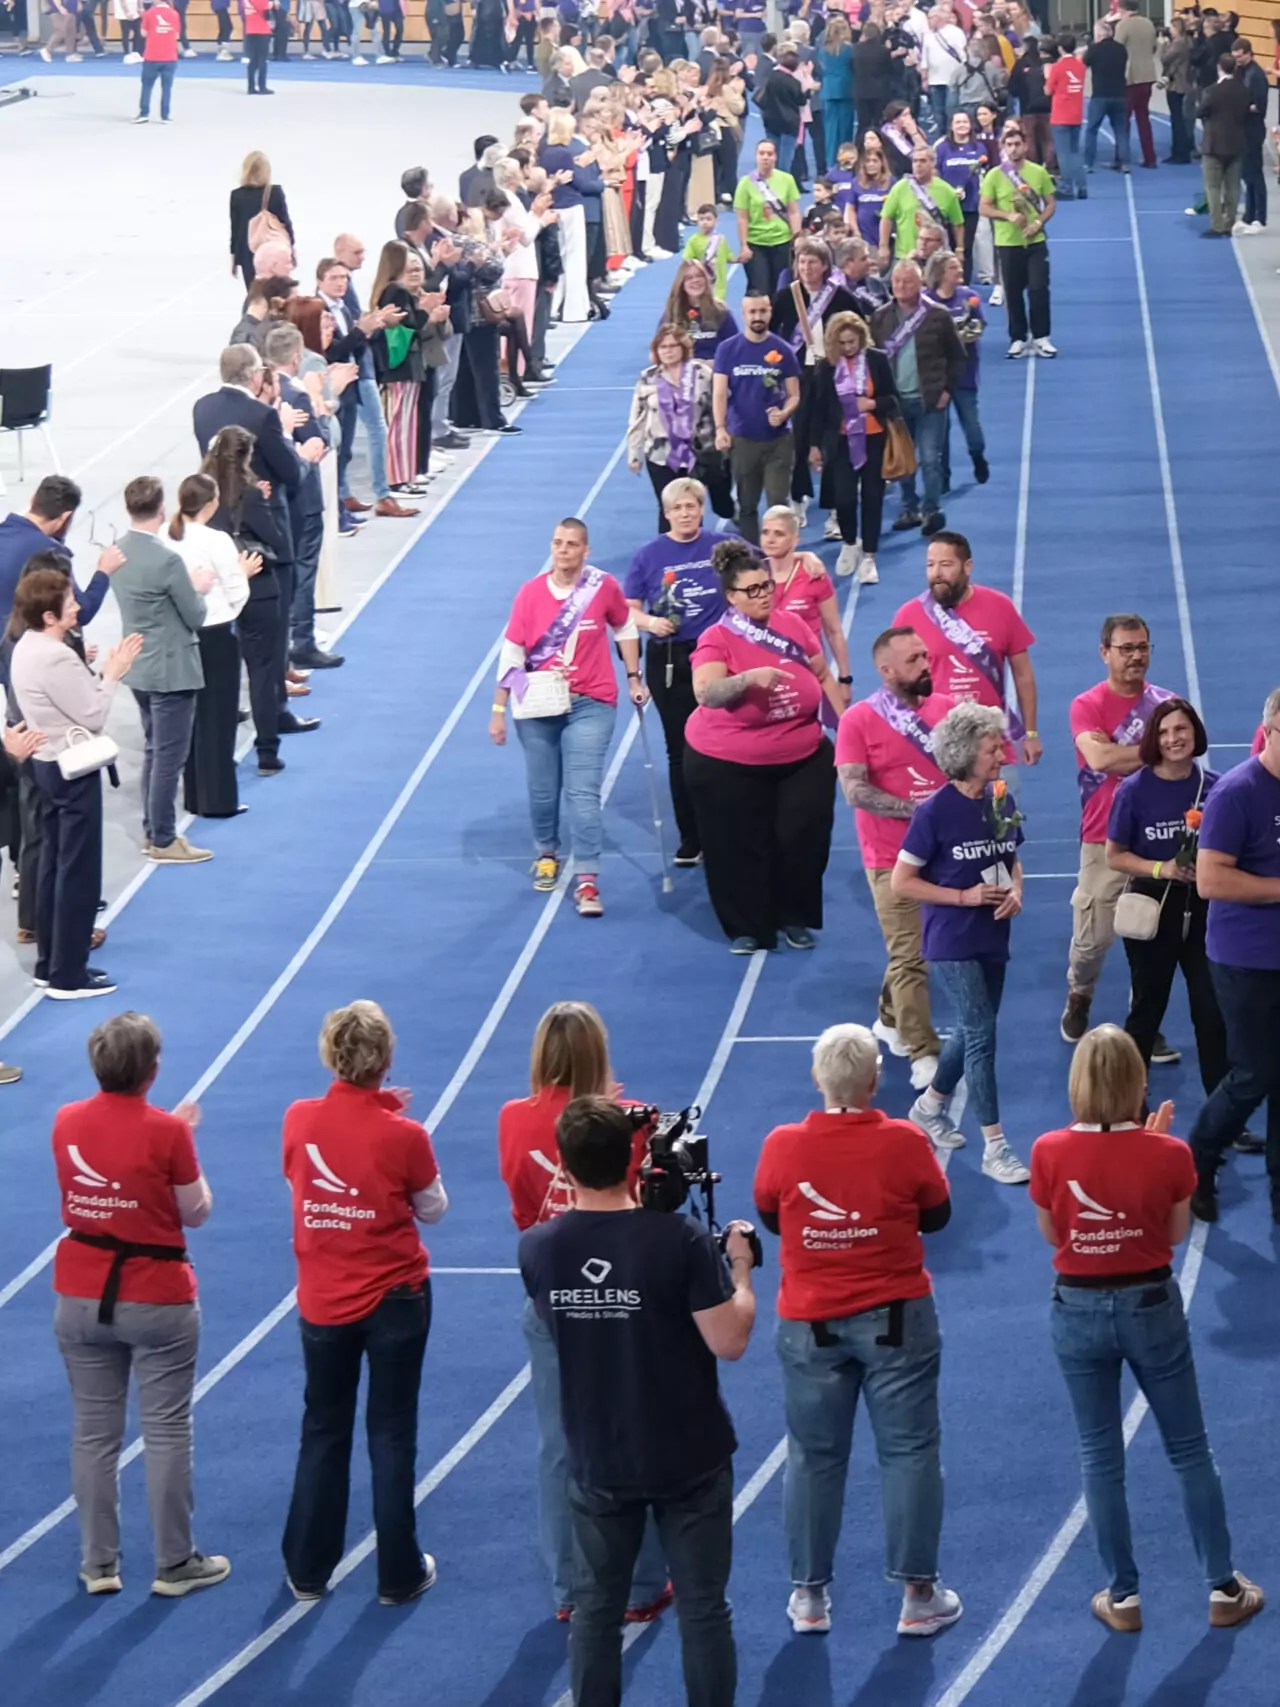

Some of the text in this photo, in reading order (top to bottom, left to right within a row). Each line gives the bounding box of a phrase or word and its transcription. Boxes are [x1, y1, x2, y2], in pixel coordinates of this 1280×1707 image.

[731, 614, 790, 653] Caregiver
[952, 841, 1016, 860] Survivo
[67, 1190, 139, 1209] Fondation
[68, 1203, 113, 1219] Cancer
[303, 1199, 376, 1219] Fondation
[303, 1215, 352, 1231] Cancer
[802, 1226, 878, 1240] Fondation
[1070, 1227, 1144, 1241] Fondation
[803, 1239, 854, 1250] Cancer
[1072, 1242, 1121, 1254] Cancer
[550, 1288, 641, 1305] FREELENS
[566, 1311, 594, 1319] Media
[594, 1311, 601, 1319] &
